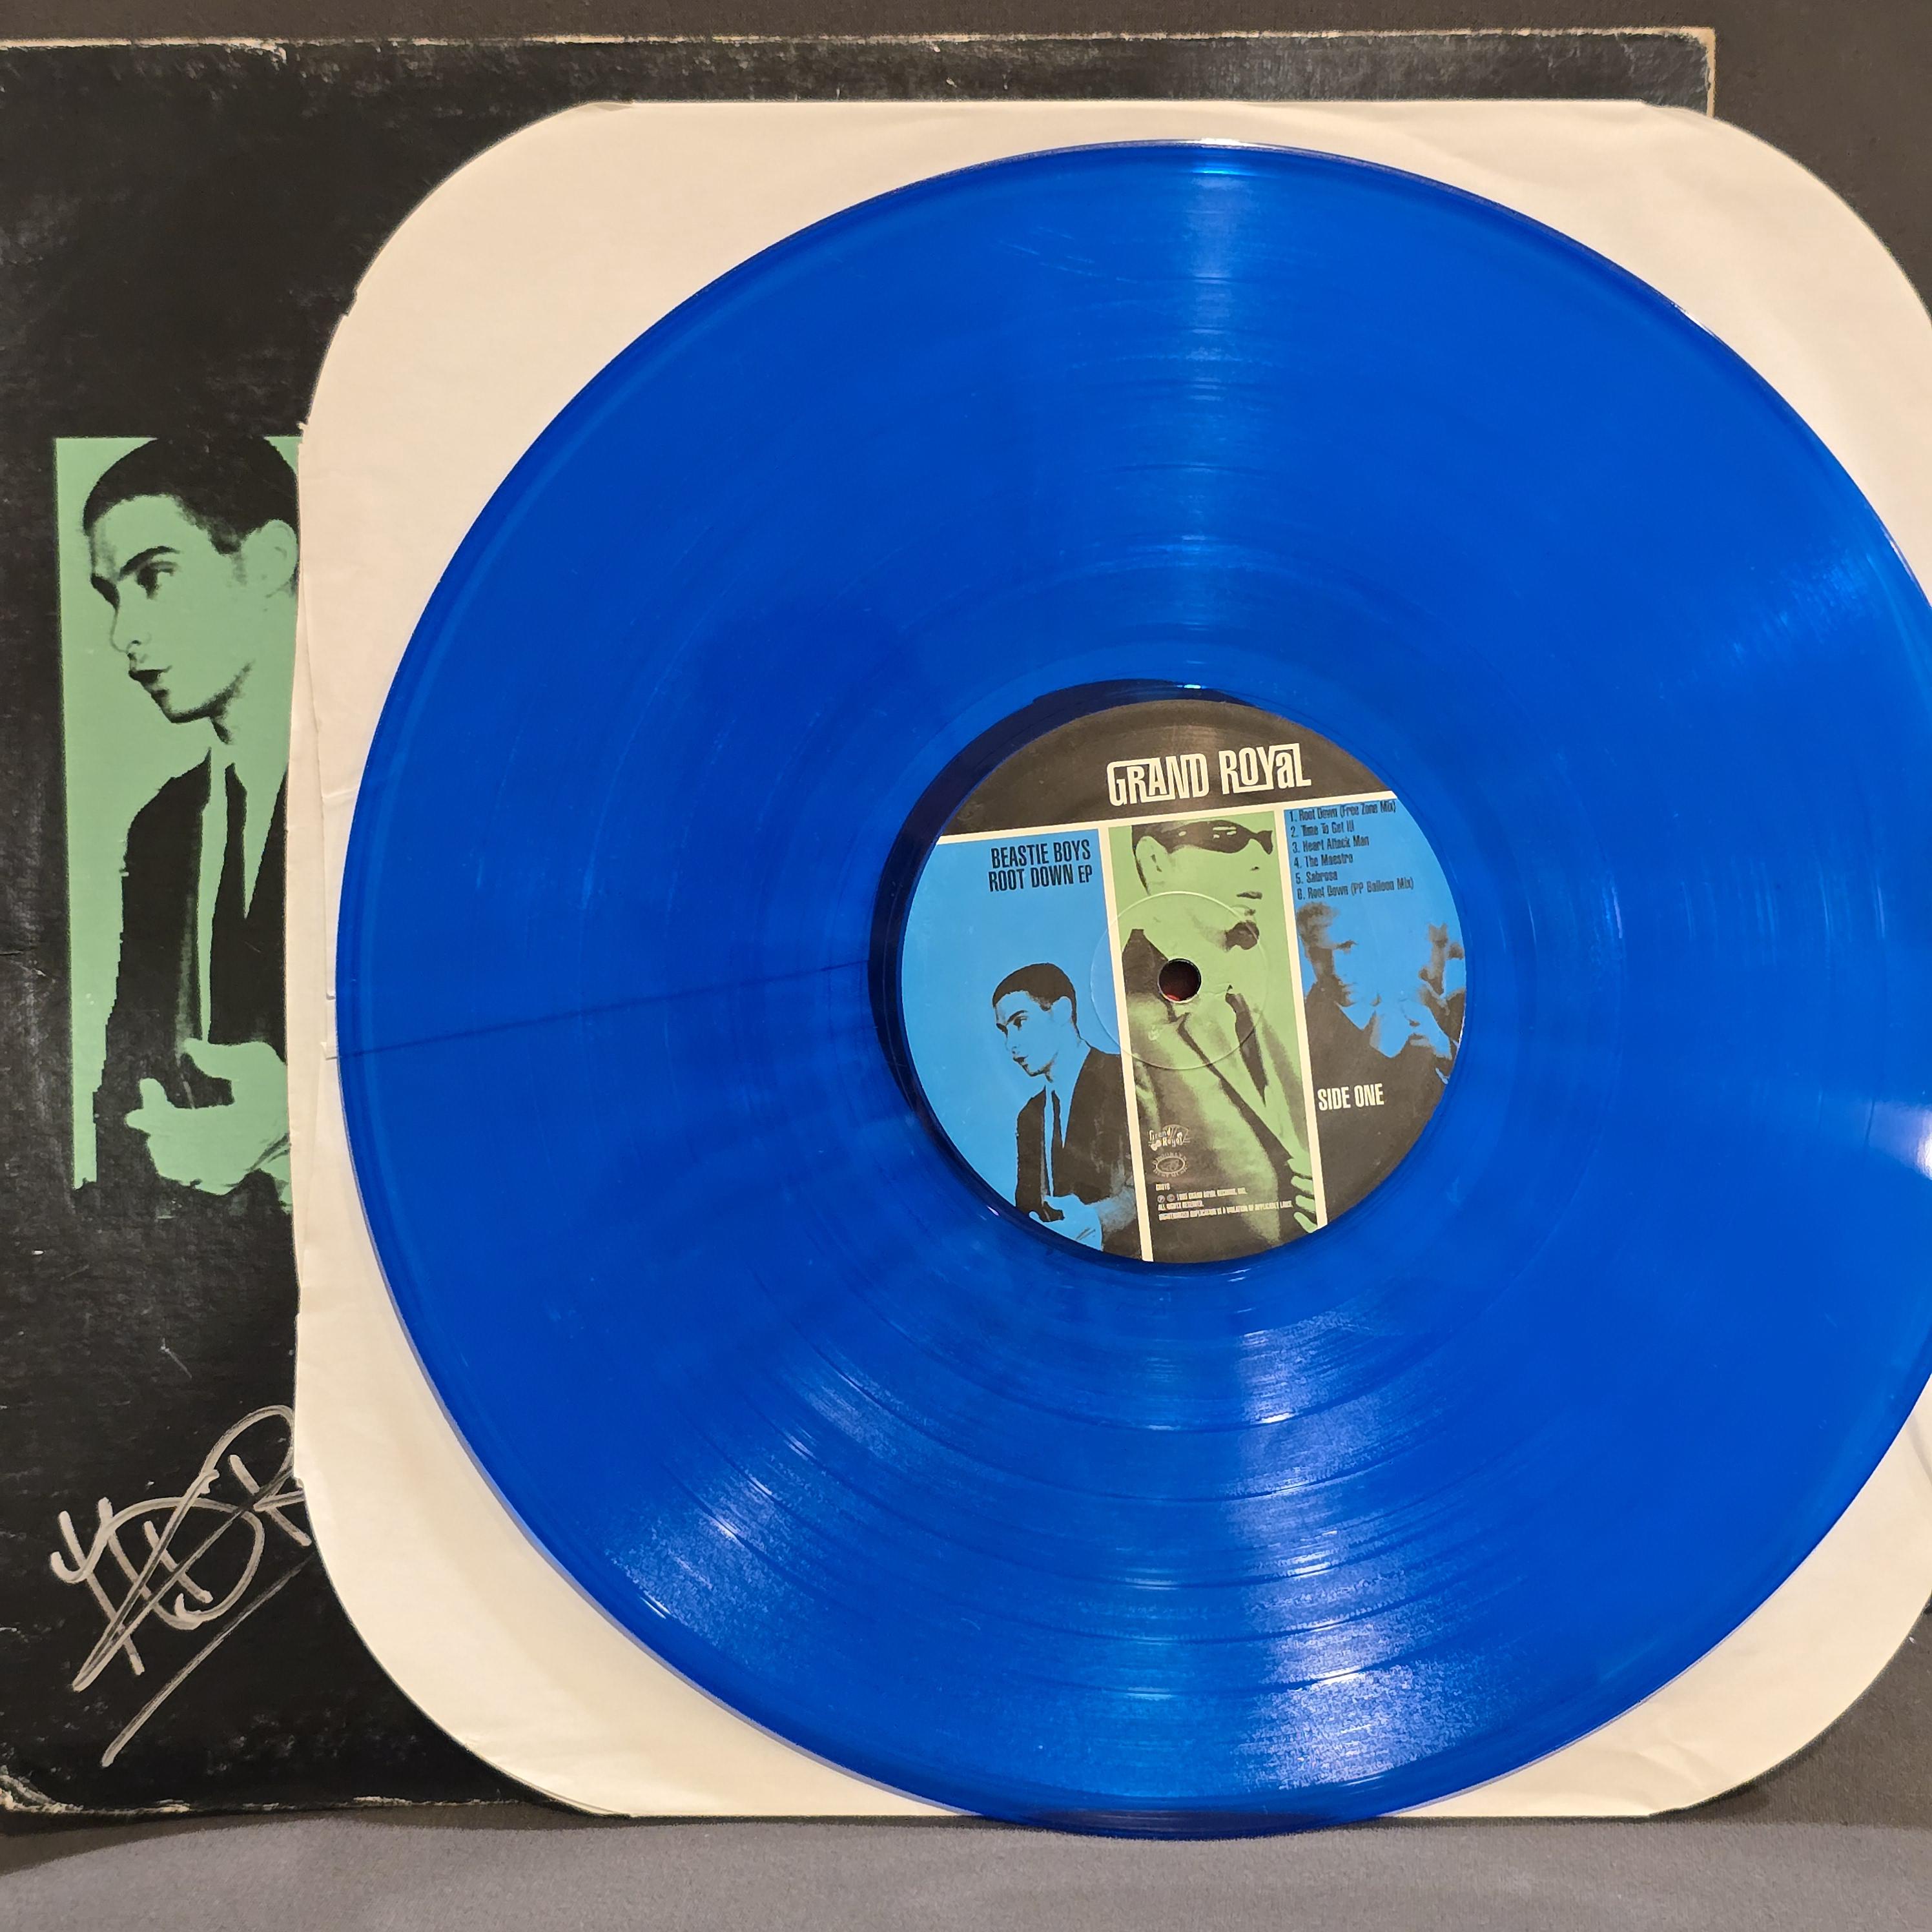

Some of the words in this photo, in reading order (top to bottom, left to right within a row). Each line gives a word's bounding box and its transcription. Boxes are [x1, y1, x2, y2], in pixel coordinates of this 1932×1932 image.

[1106, 753, 1209, 807] GRAND
[1290, 811, 1297, 822] 1.
[1321, 823, 1329, 834] To
[1331, 821, 1344, 834] Get
[1292, 841, 1300, 854] 3.
[1302, 839, 1324, 852] Heart
[1353, 835, 1370, 847] Man
[991, 843, 1049, 868] BEASTIE
[1053, 839, 1091, 863] BOYS
[1293, 857, 1302, 868] 4.
[1304, 856, 1319, 868] The
[1321, 853, 1353, 866] Maestro
[988, 868, 1025, 892] ROOT
[1030, 864, 1074, 888] DOWN
[1078, 865, 1093, 883] EP
[1295, 872, 1304, 884] 5.
[1306, 870, 1338, 883] Sabrosa
[1308, 887, 1325, 899] Root
[1317, 1086, 1351, 1111] SIDE
[1354, 1083, 1384, 1107] ONE
